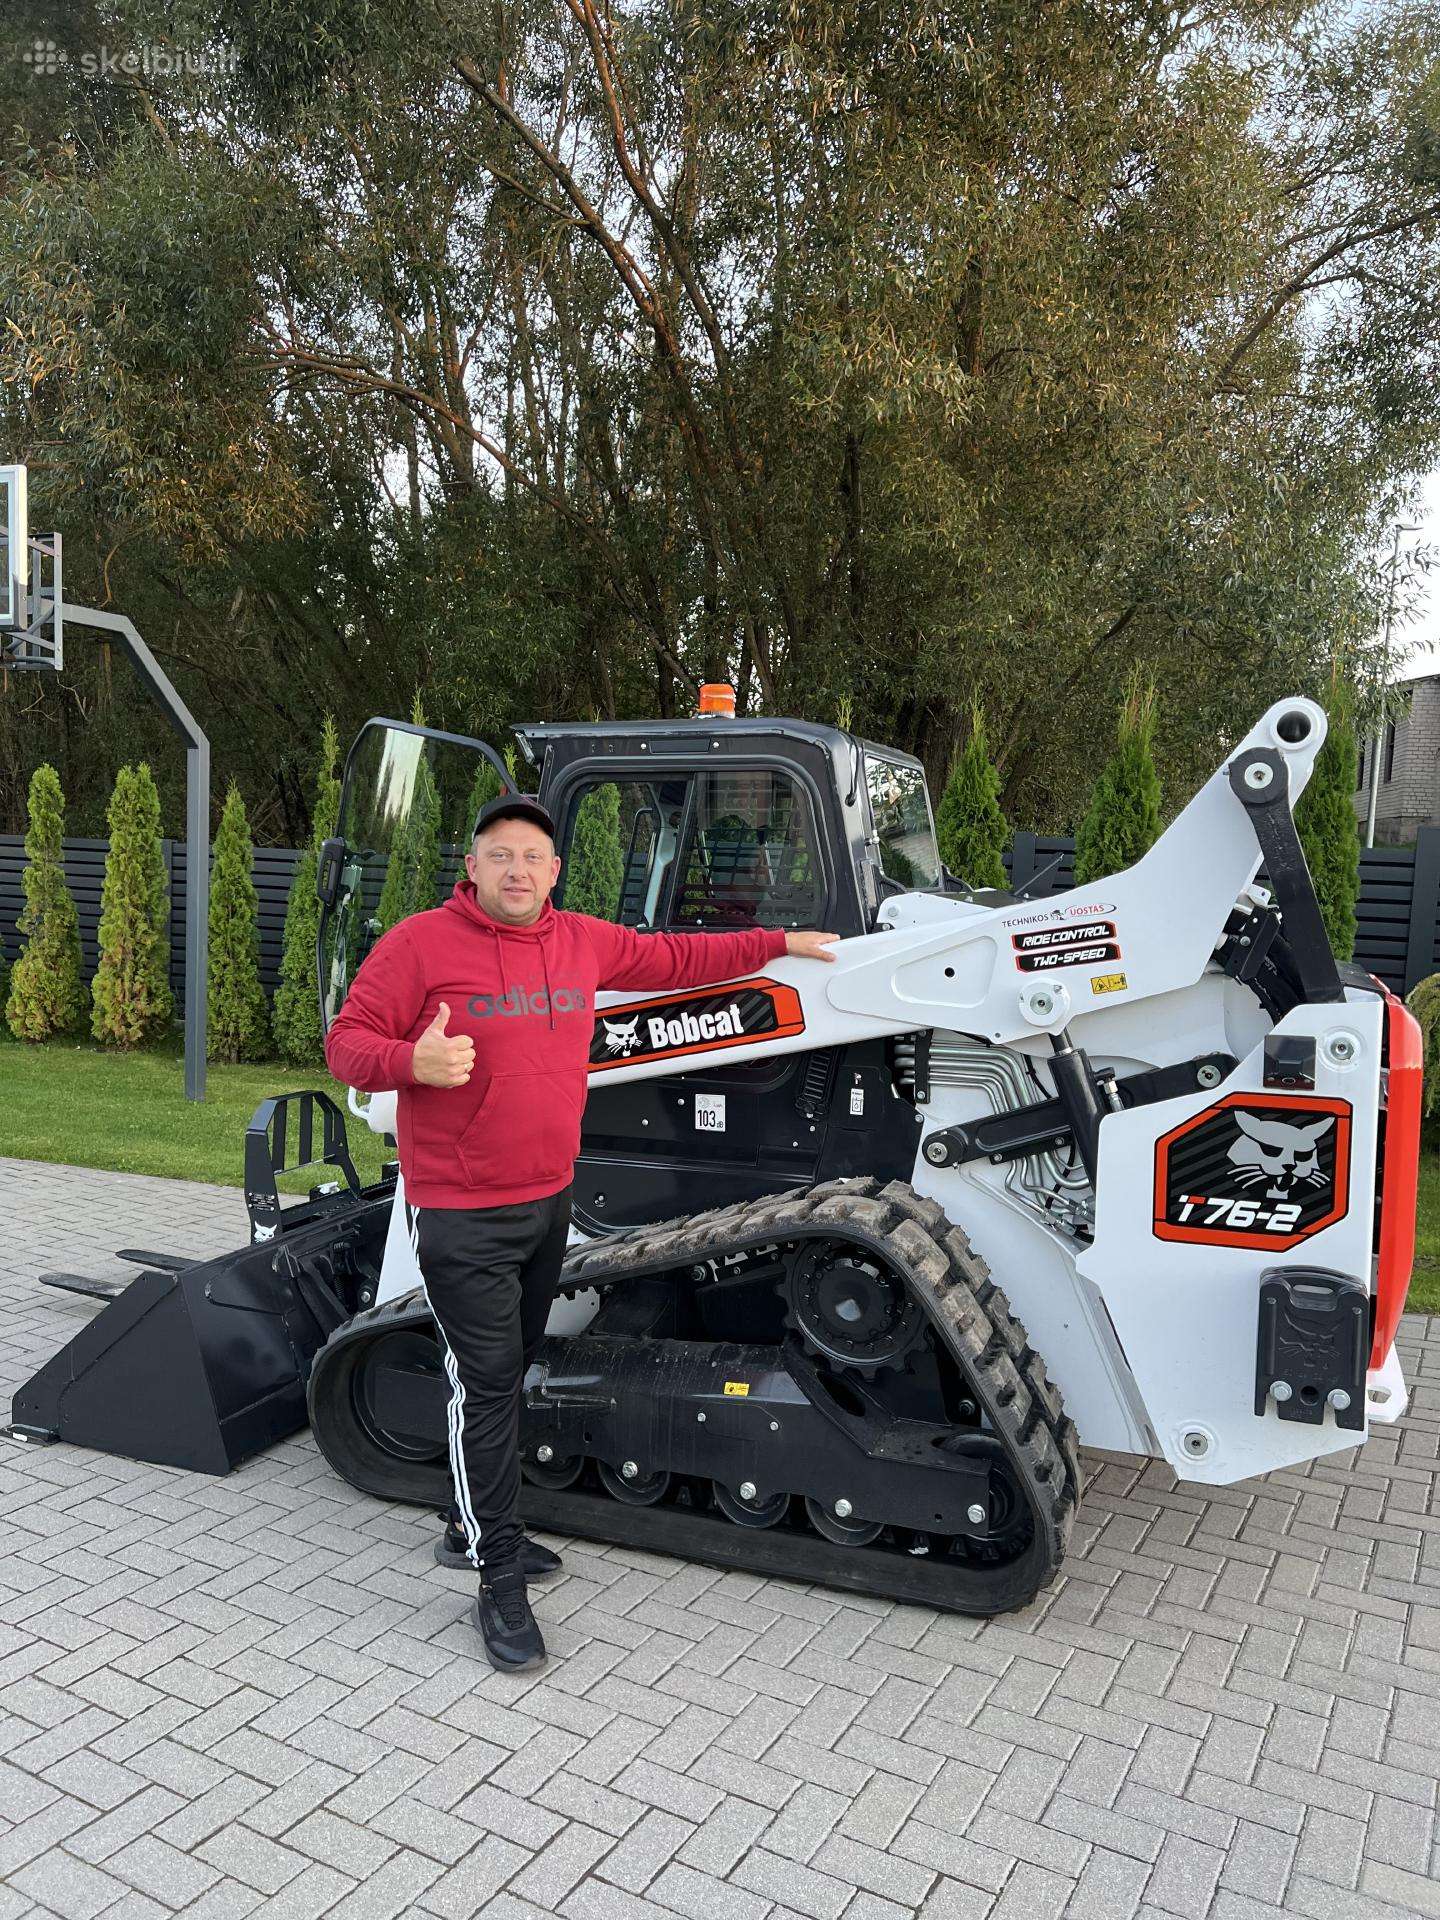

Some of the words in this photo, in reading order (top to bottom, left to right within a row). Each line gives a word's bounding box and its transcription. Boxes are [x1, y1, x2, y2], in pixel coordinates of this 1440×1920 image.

[1001, 913, 1049, 928] TECHNIKOS
[1070, 905, 1105, 917] UOSTAS
[1022, 933, 1051, 948] RIDE
[1051, 925, 1110, 943] CONTROL
[1033, 947, 1107, 968] TWO-SPEED
[466, 984, 587, 1019] adidas
[648, 1003, 745, 1049] Bobcat
[697, 1109, 716, 1127] 103
[1178, 1194, 1303, 1232] T76-2
